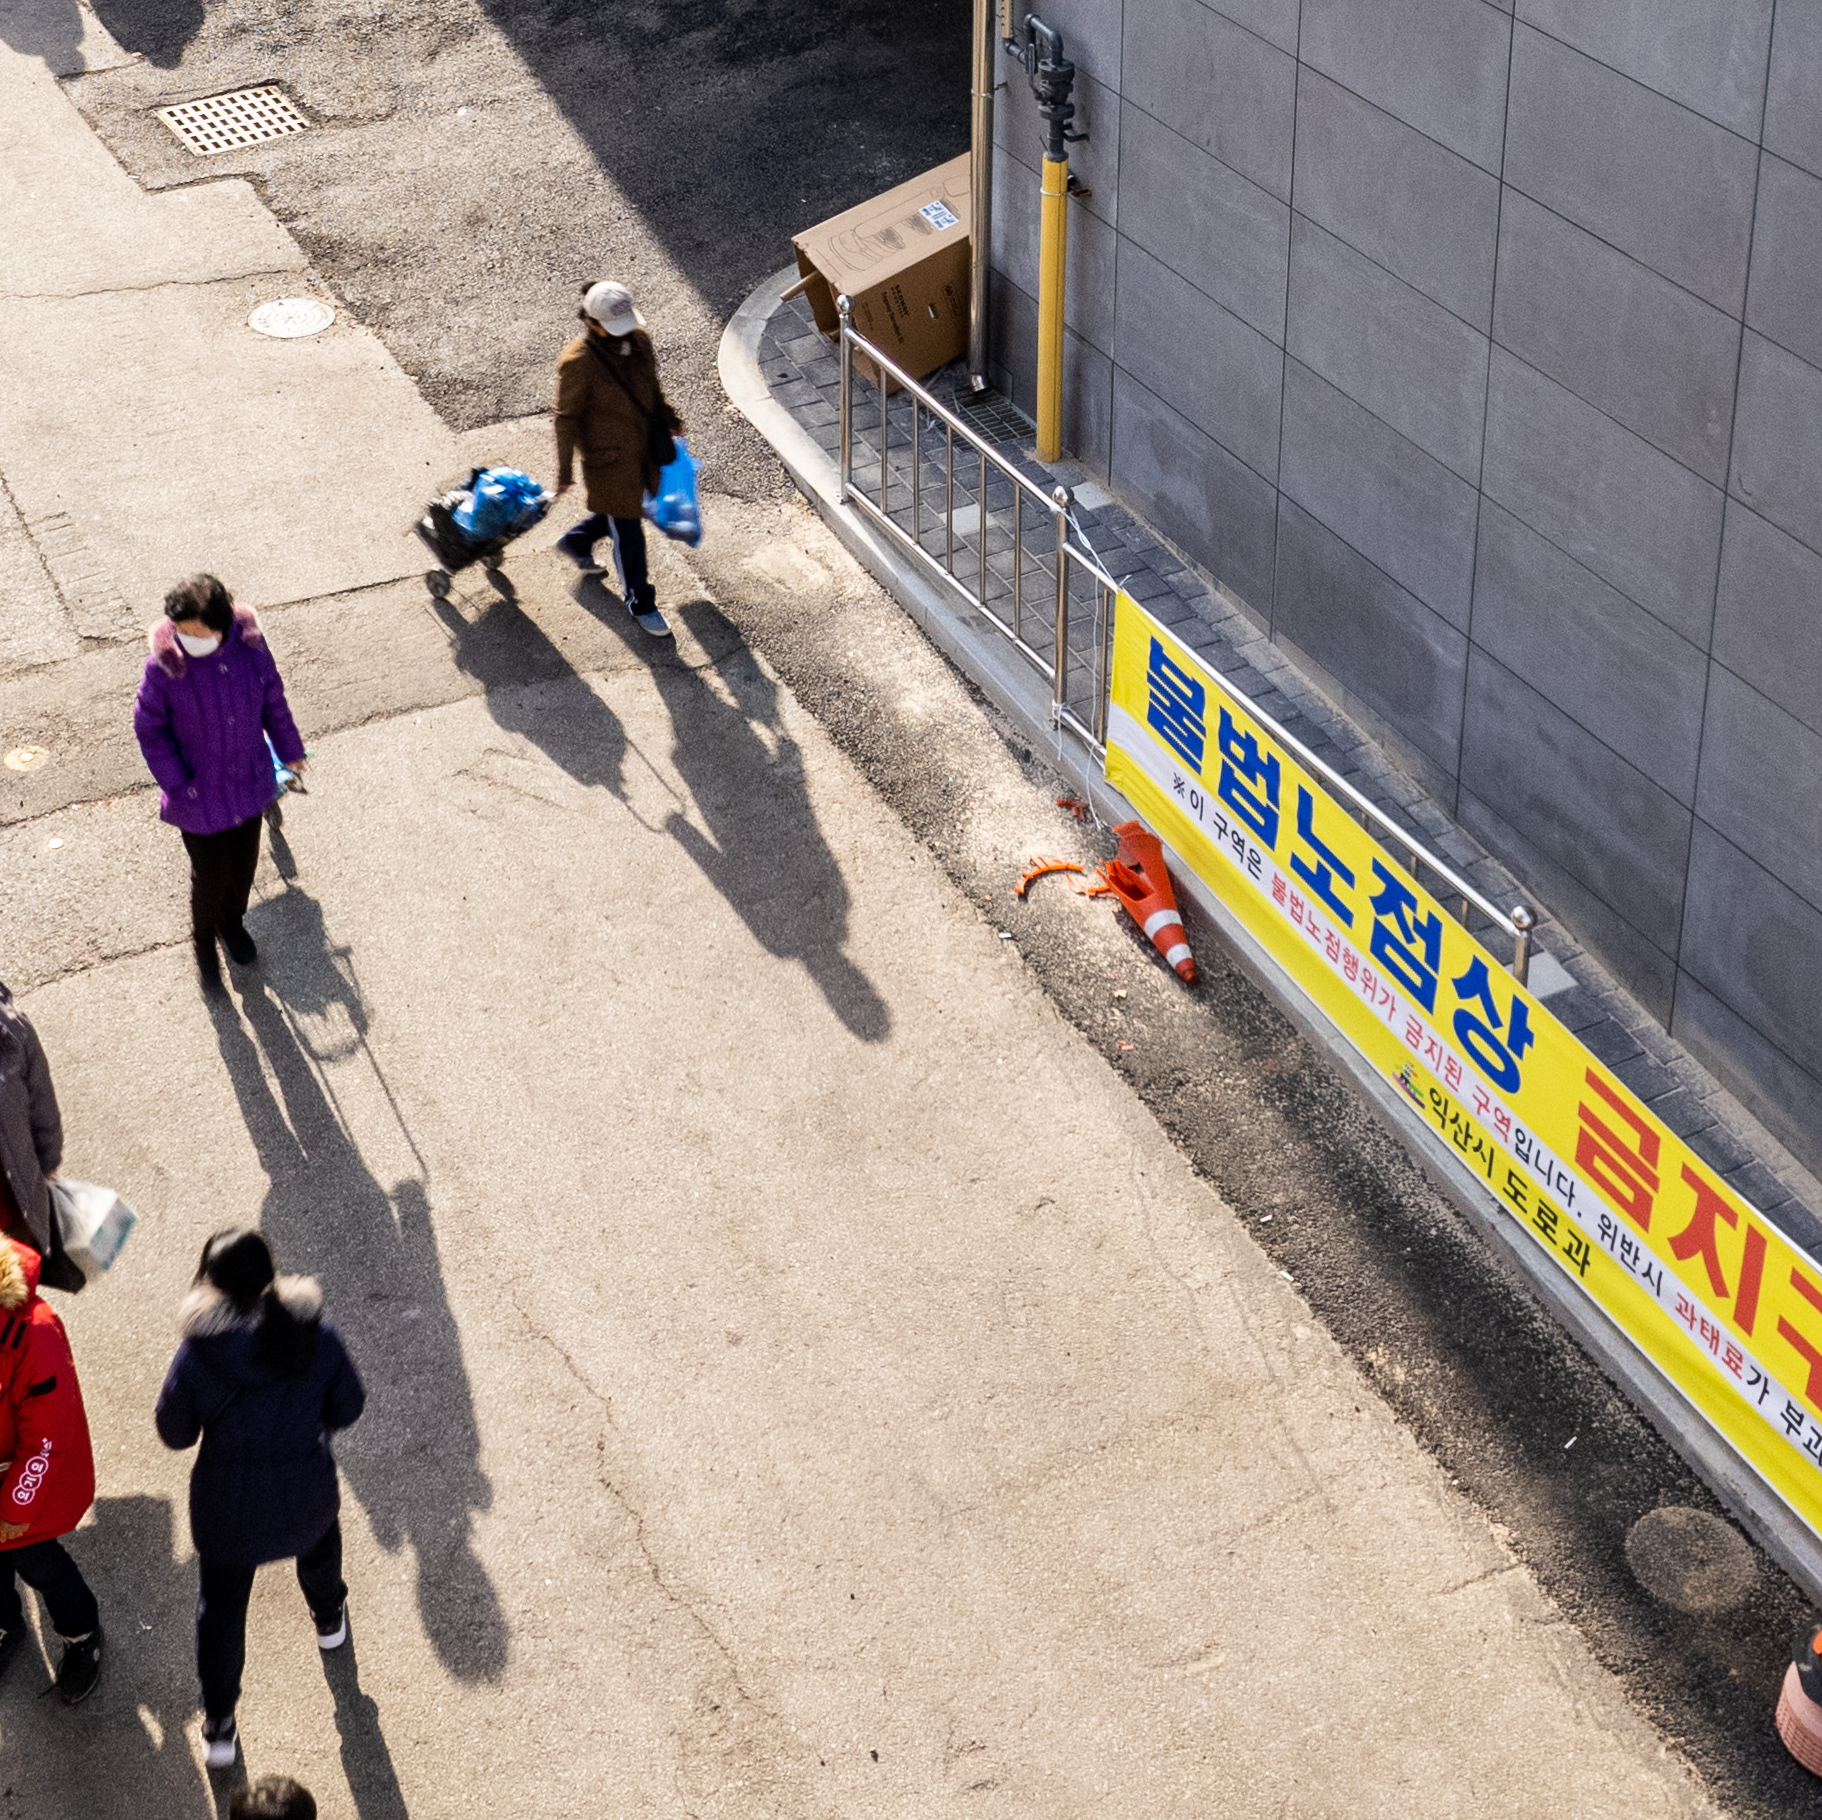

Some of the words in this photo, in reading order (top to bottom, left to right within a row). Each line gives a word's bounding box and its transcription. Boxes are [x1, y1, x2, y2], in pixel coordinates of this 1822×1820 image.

[1144, 635, 1536, 1097] 불법노점상
[1213, 812, 1264, 882] 구역은
[1269, 870, 1398, 1023] 불법노점행위가
[1404, 1018, 1465, 1094] 금지된
[1471, 1086, 1583, 1219] 구역입니다.
[1596, 1211, 1664, 1298] 위반시
[1675, 1291, 1771, 1406] 과태료가
[1429, 1086, 1495, 1179] 익산시
[1503, 1164, 1592, 1279] 도로과
